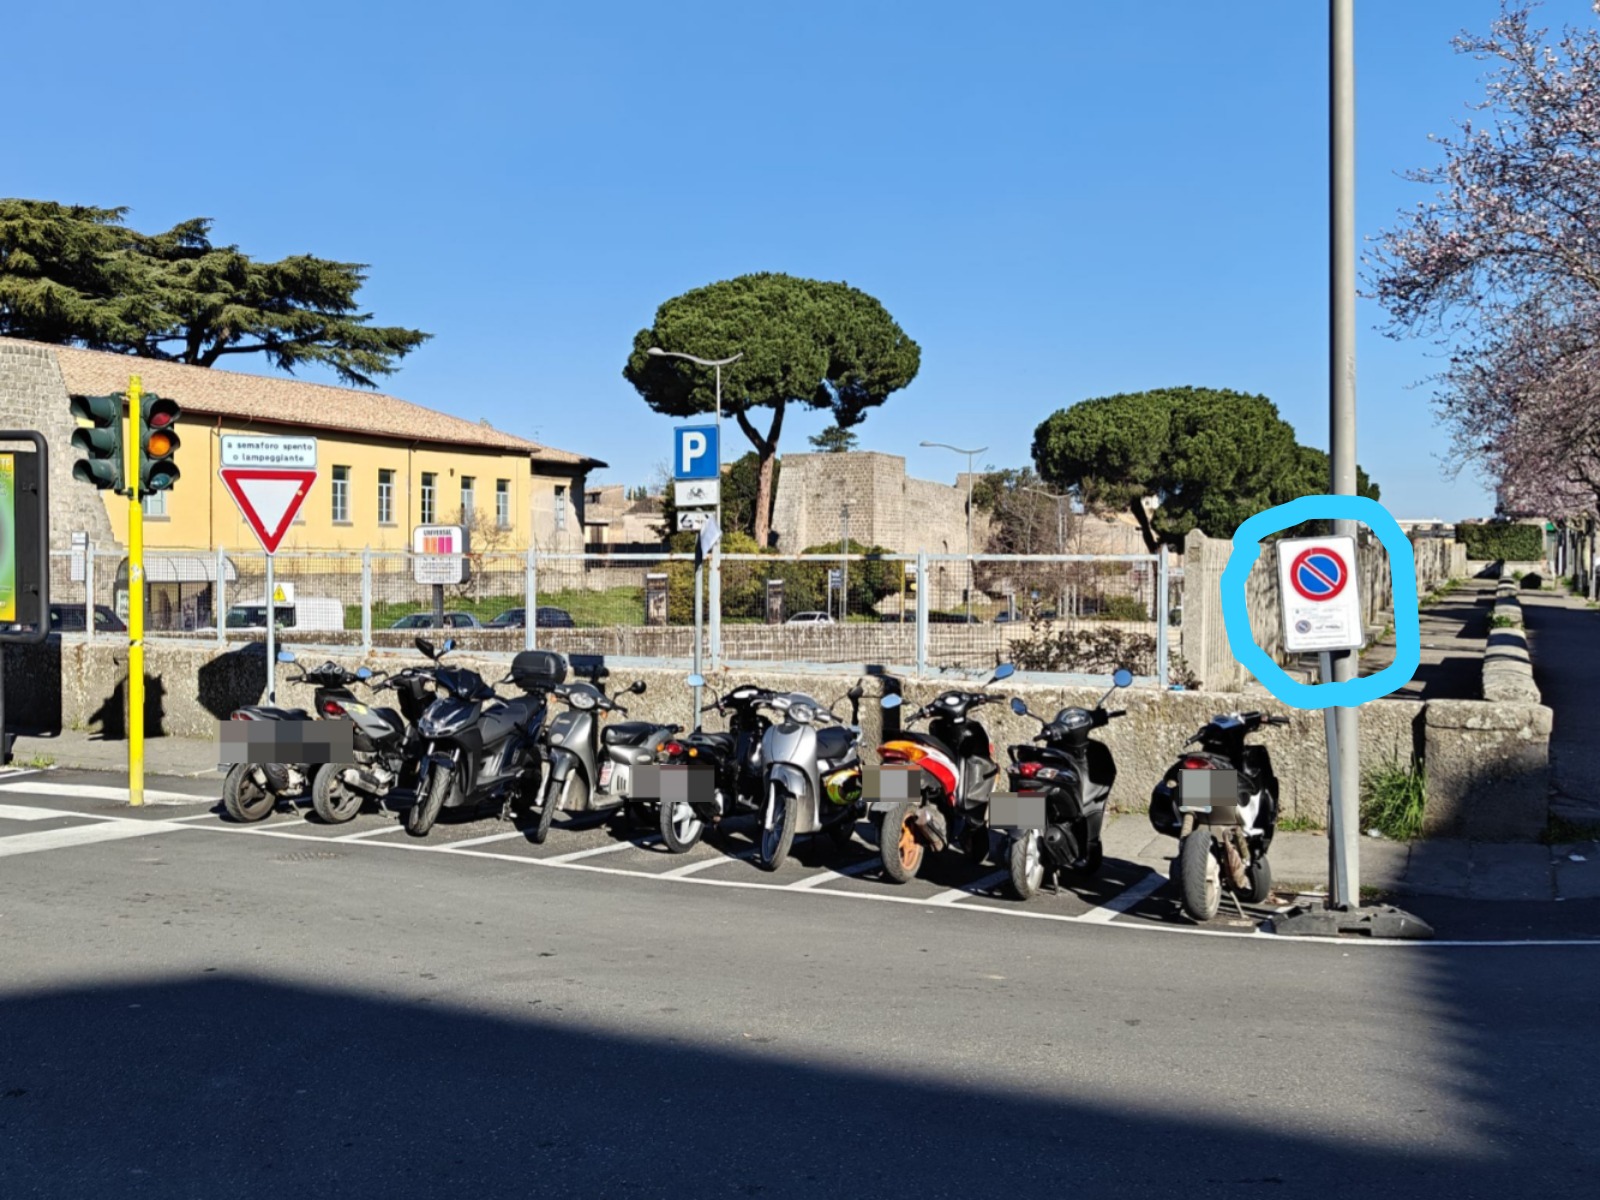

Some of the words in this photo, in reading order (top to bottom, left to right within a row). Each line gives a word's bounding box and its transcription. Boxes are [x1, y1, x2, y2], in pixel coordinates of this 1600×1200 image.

[237, 442, 279, 450] semaforo
[283, 443, 312, 451] spento
[682, 431, 707, 472] P
[242, 453, 304, 463] lampeggiante
